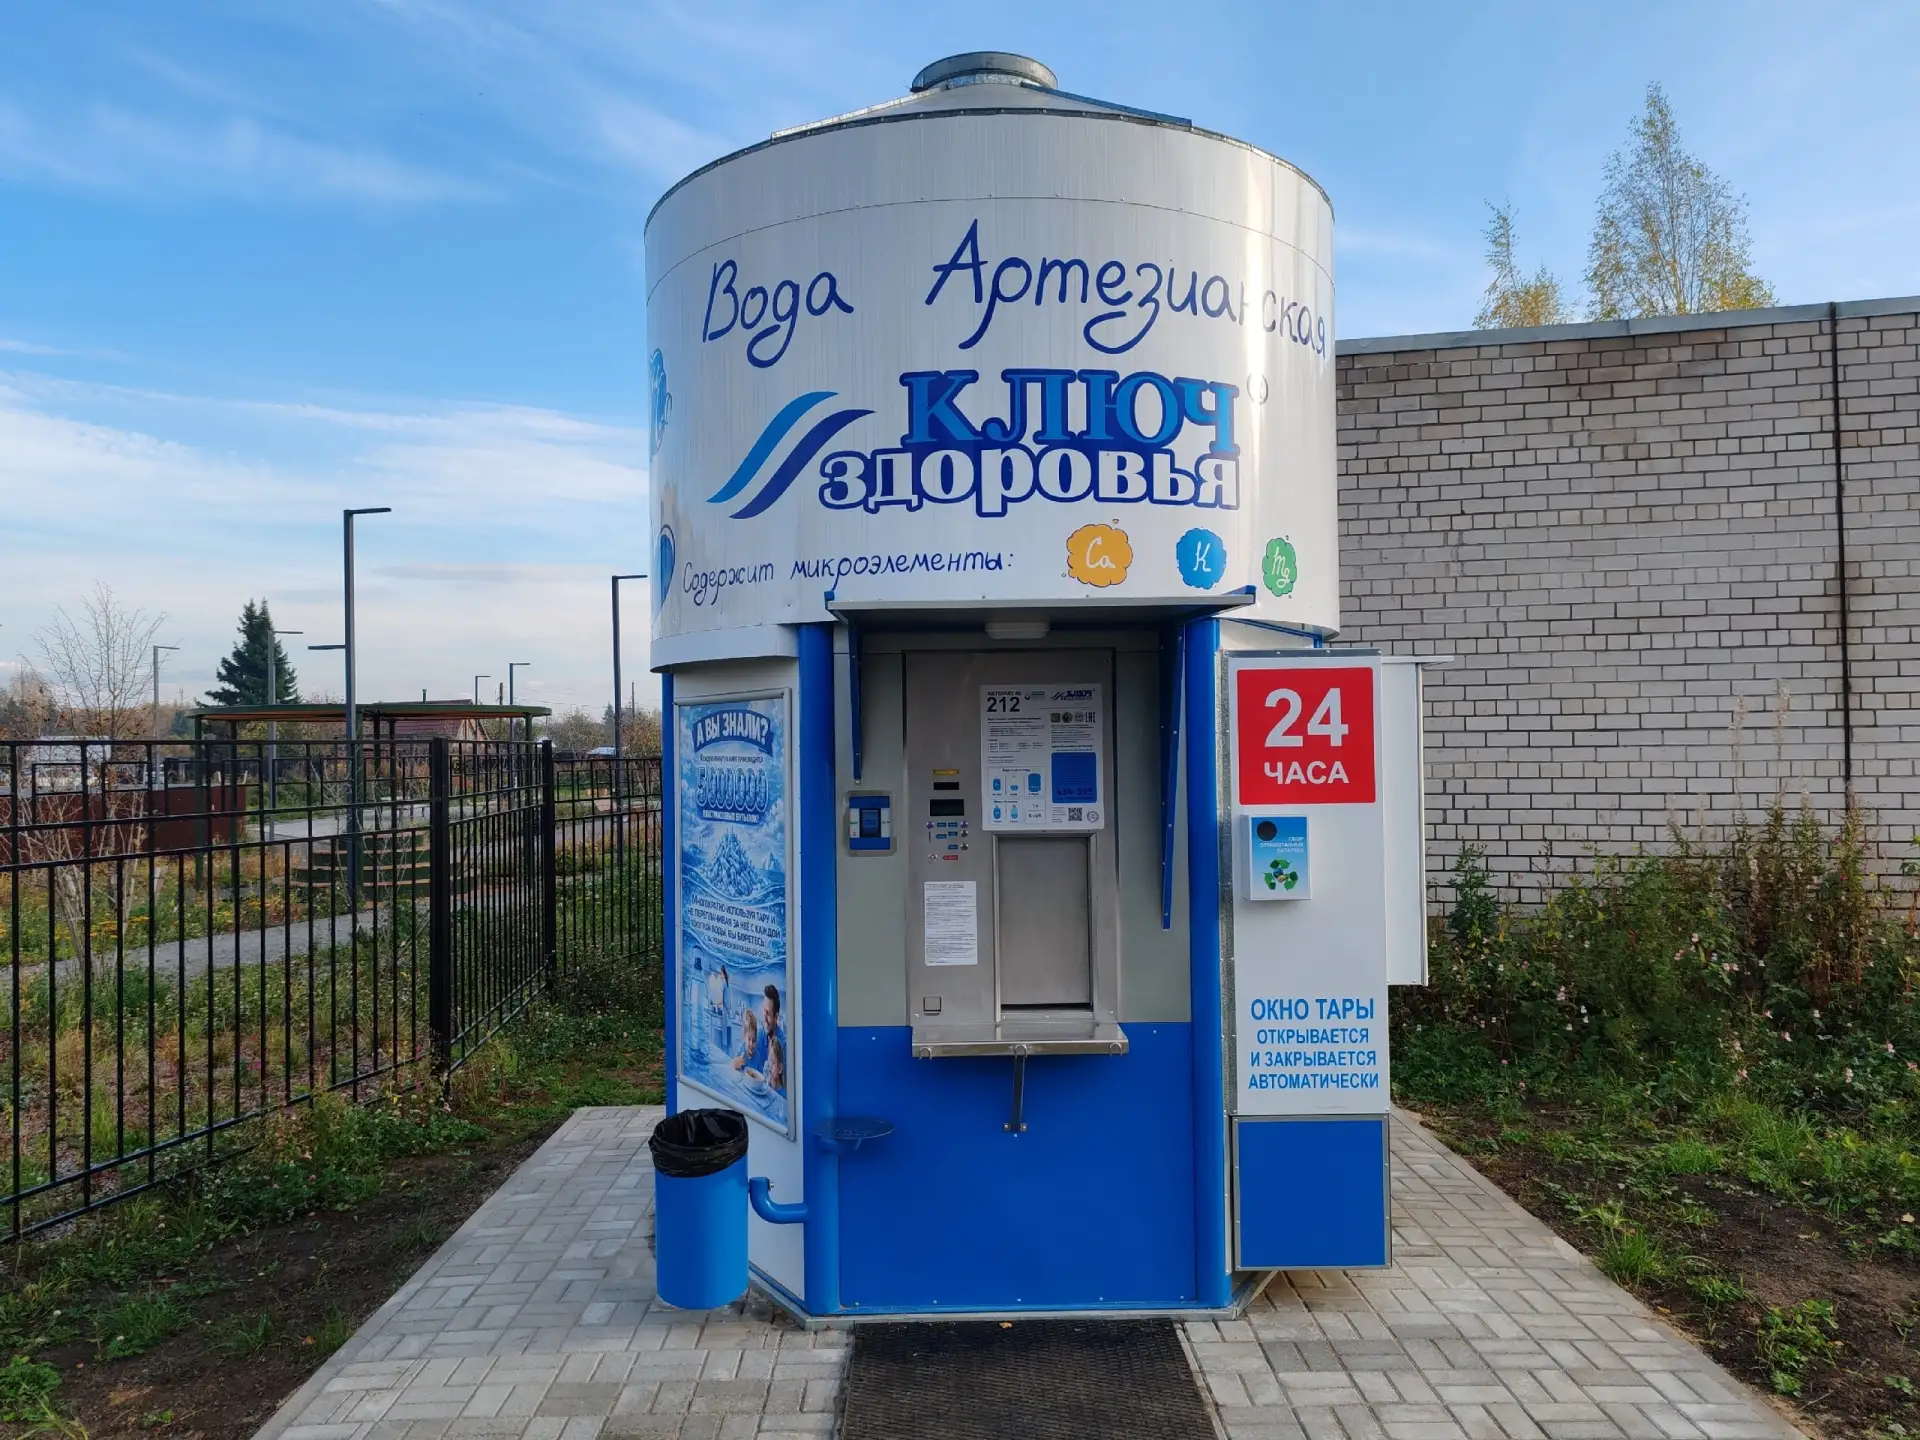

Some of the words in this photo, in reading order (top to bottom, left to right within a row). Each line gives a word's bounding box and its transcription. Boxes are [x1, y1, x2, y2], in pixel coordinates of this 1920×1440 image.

[702, 258, 854, 369] Вода
[1085, 536, 1117, 569] Ca
[683, 562, 774, 606] Содержит
[986, 696, 1020, 712] 212
[1264, 687, 1349, 747] 24
[696, 722, 704, 747] А
[705, 714, 720, 741] ВЫ
[722, 712, 769, 745] ЗНАЛИ?
[1264, 761, 1350, 784] ЧАСА
[1251, 998, 1309, 1020] ОКНО
[1315, 998, 1374, 1020] ТАРЫ
[1256, 1028, 1369, 1044] ОТКРЫВАЕТСЯ
[1250, 1051, 1260, 1067] И
[1264, 1050, 1376, 1067] ЗАКРЫВАЕТСЯ
[1248, 1072, 1379, 1089] АВТОМАТИЧЕСКИ
